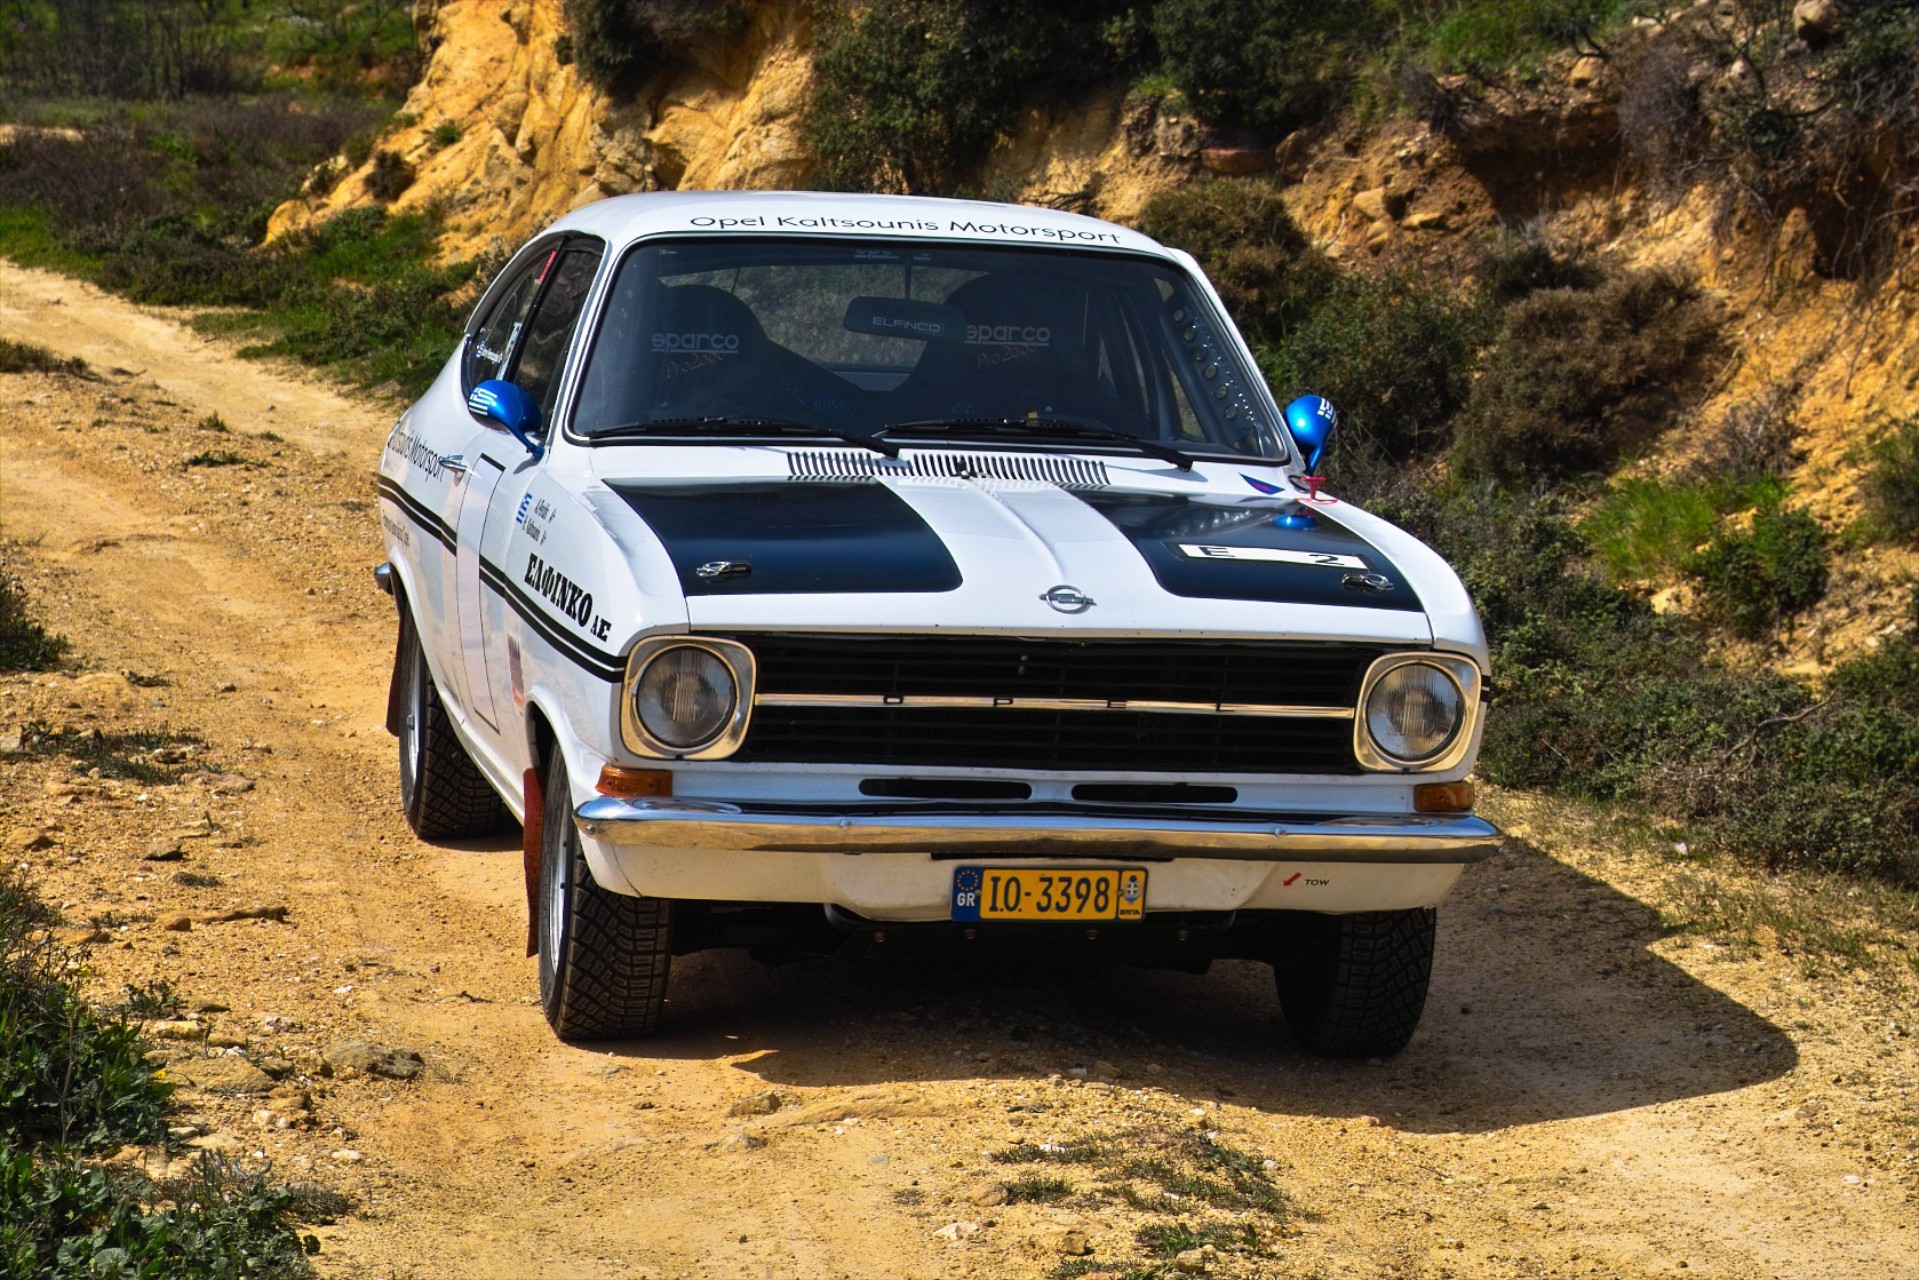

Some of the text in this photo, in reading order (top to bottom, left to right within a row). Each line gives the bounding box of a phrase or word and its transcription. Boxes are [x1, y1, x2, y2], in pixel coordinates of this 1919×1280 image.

[690, 216, 1120, 243] Opel Kaltsounis Motorsport
[873, 316, 941, 332] ELFINCO
[966, 324, 1051, 344] sparco
[652, 333, 739, 353] sparco
[1198, 547, 1345, 566] E 2
[524, 552, 593, 628] ΕΛΦΙΝΚΟ
[957, 893, 975, 907] GR
